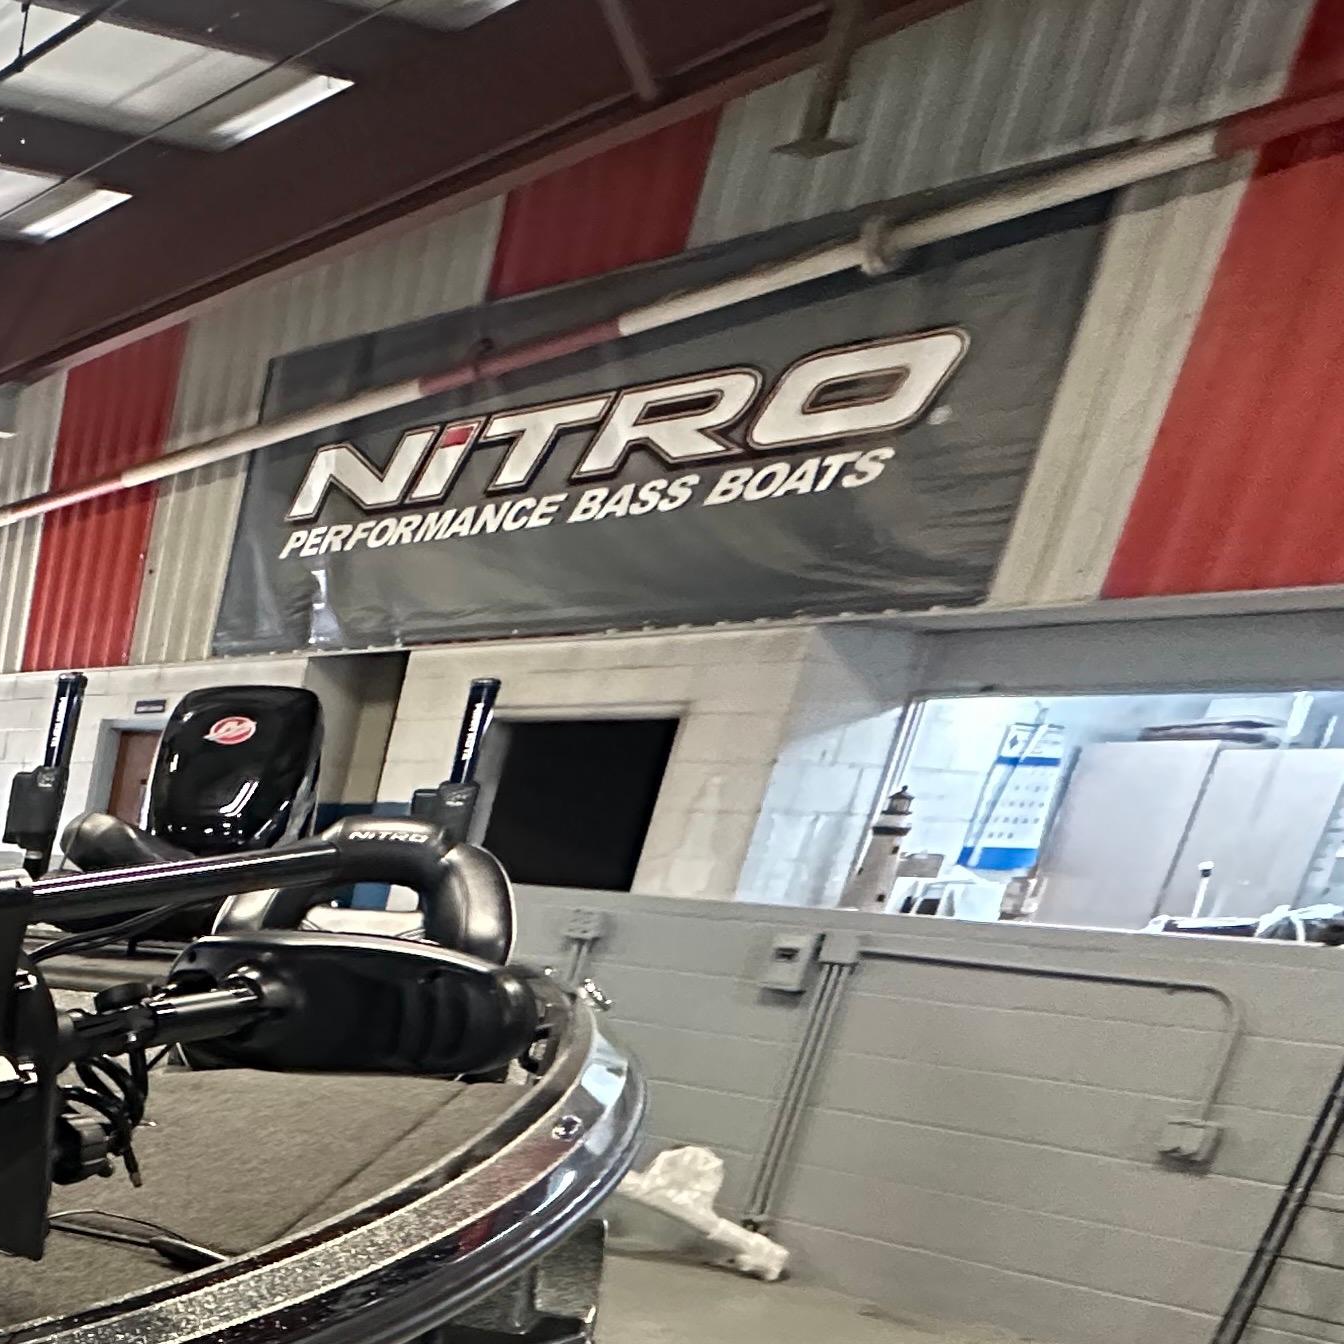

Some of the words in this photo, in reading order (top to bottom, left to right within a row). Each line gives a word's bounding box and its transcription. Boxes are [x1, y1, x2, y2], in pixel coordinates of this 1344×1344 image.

[279, 495, 567, 560] PERFORMANCE
[568, 474, 700, 525] BASS
[702, 445, 897, 508] BOATS
